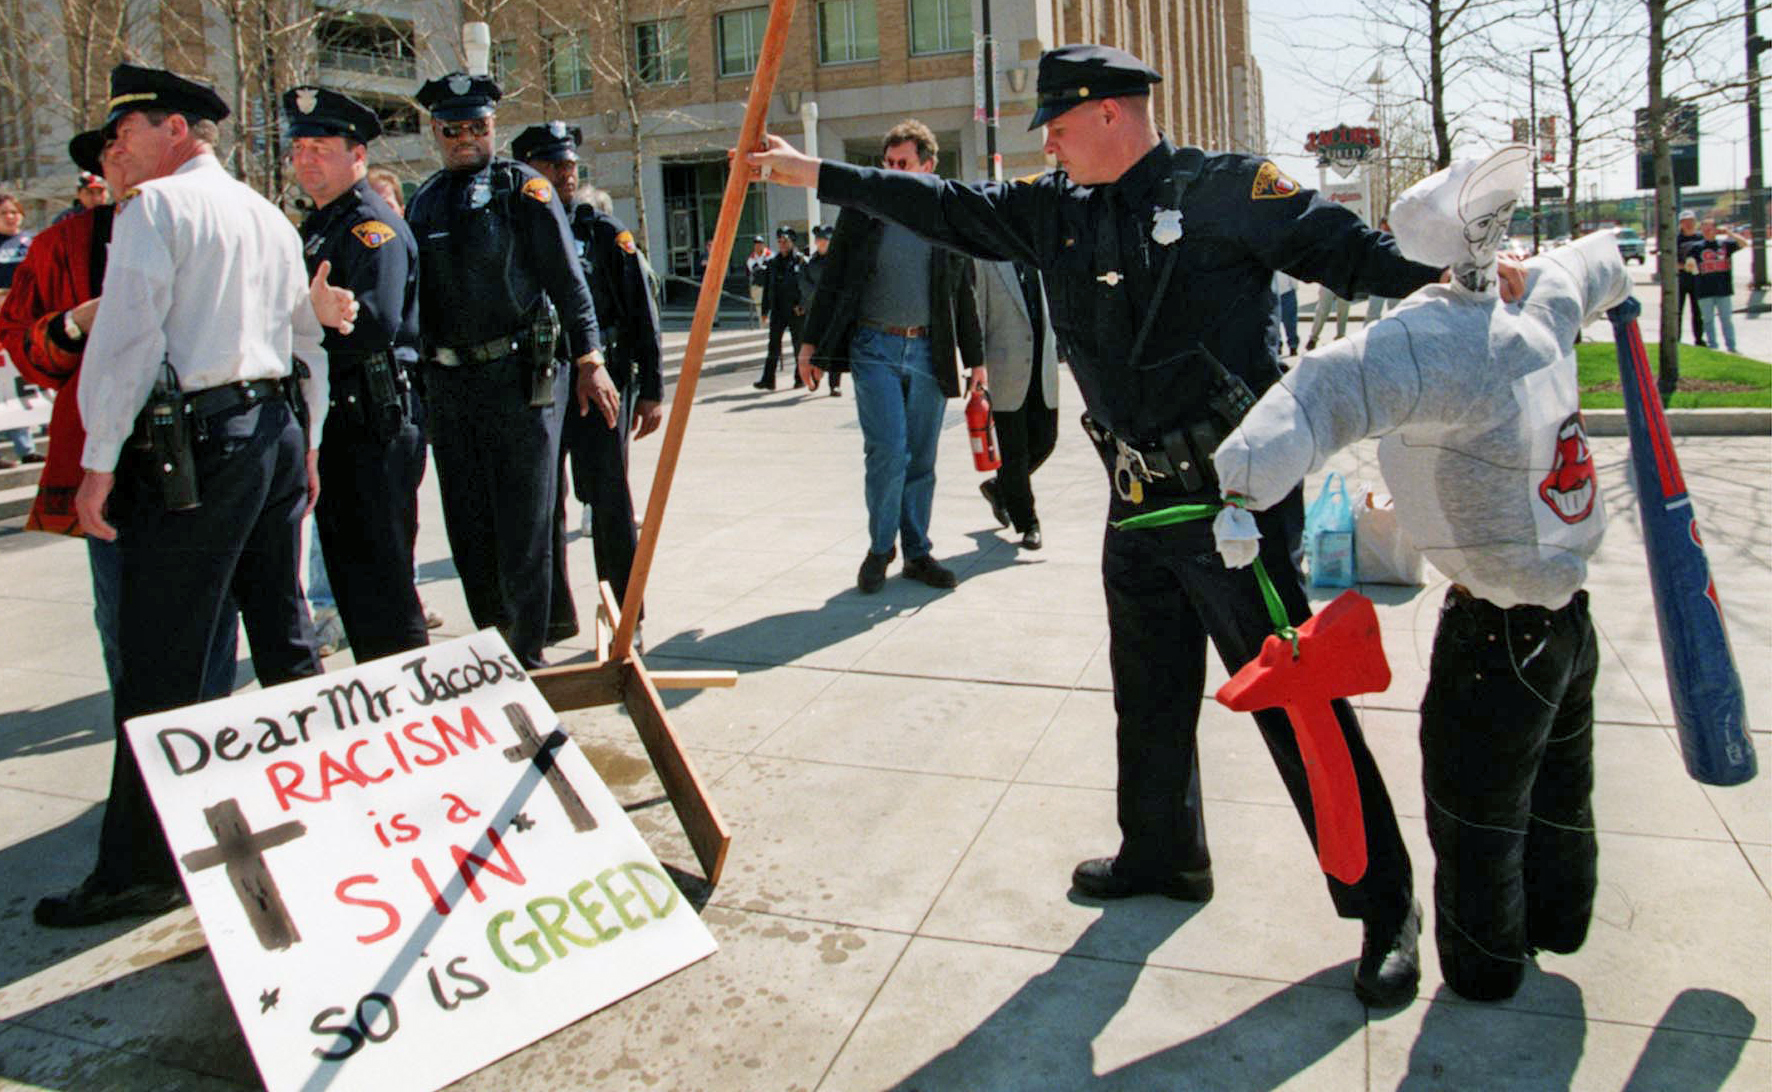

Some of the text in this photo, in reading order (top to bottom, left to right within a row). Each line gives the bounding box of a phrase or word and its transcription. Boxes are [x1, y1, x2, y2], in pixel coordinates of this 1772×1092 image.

[157, 705, 317, 776] Dear
[317, 679, 403, 729] Mr.
[266, 706, 497, 811] RACISM
[367, 793, 480, 848] is a
[335, 827, 527, 945] SIN
[421, 952, 489, 1010] is
[486, 862, 679, 974] GREED
